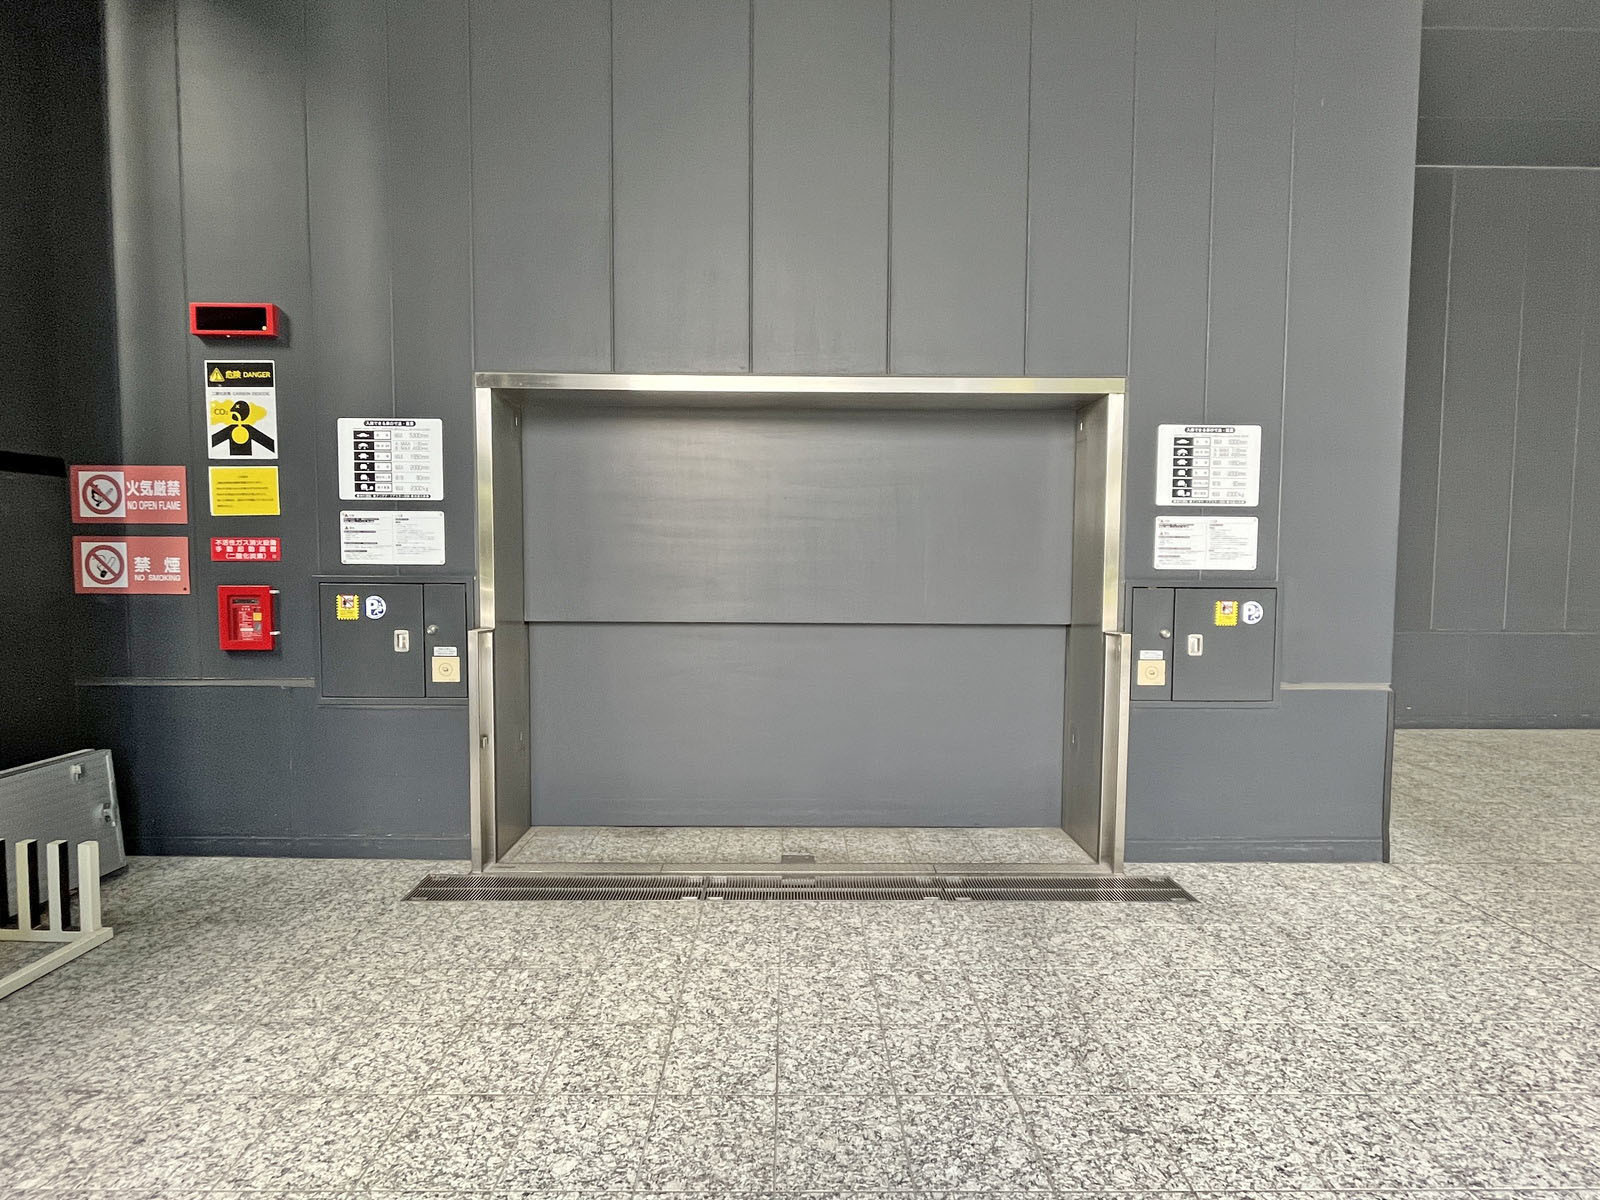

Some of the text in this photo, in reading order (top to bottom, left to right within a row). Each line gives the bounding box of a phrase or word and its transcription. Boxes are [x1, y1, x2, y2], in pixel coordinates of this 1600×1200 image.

[126, 480, 181, 496] 火気厳禁
[127, 501, 181, 511] NO OPEN FLAME
[134, 557, 181, 573] 禁煙
